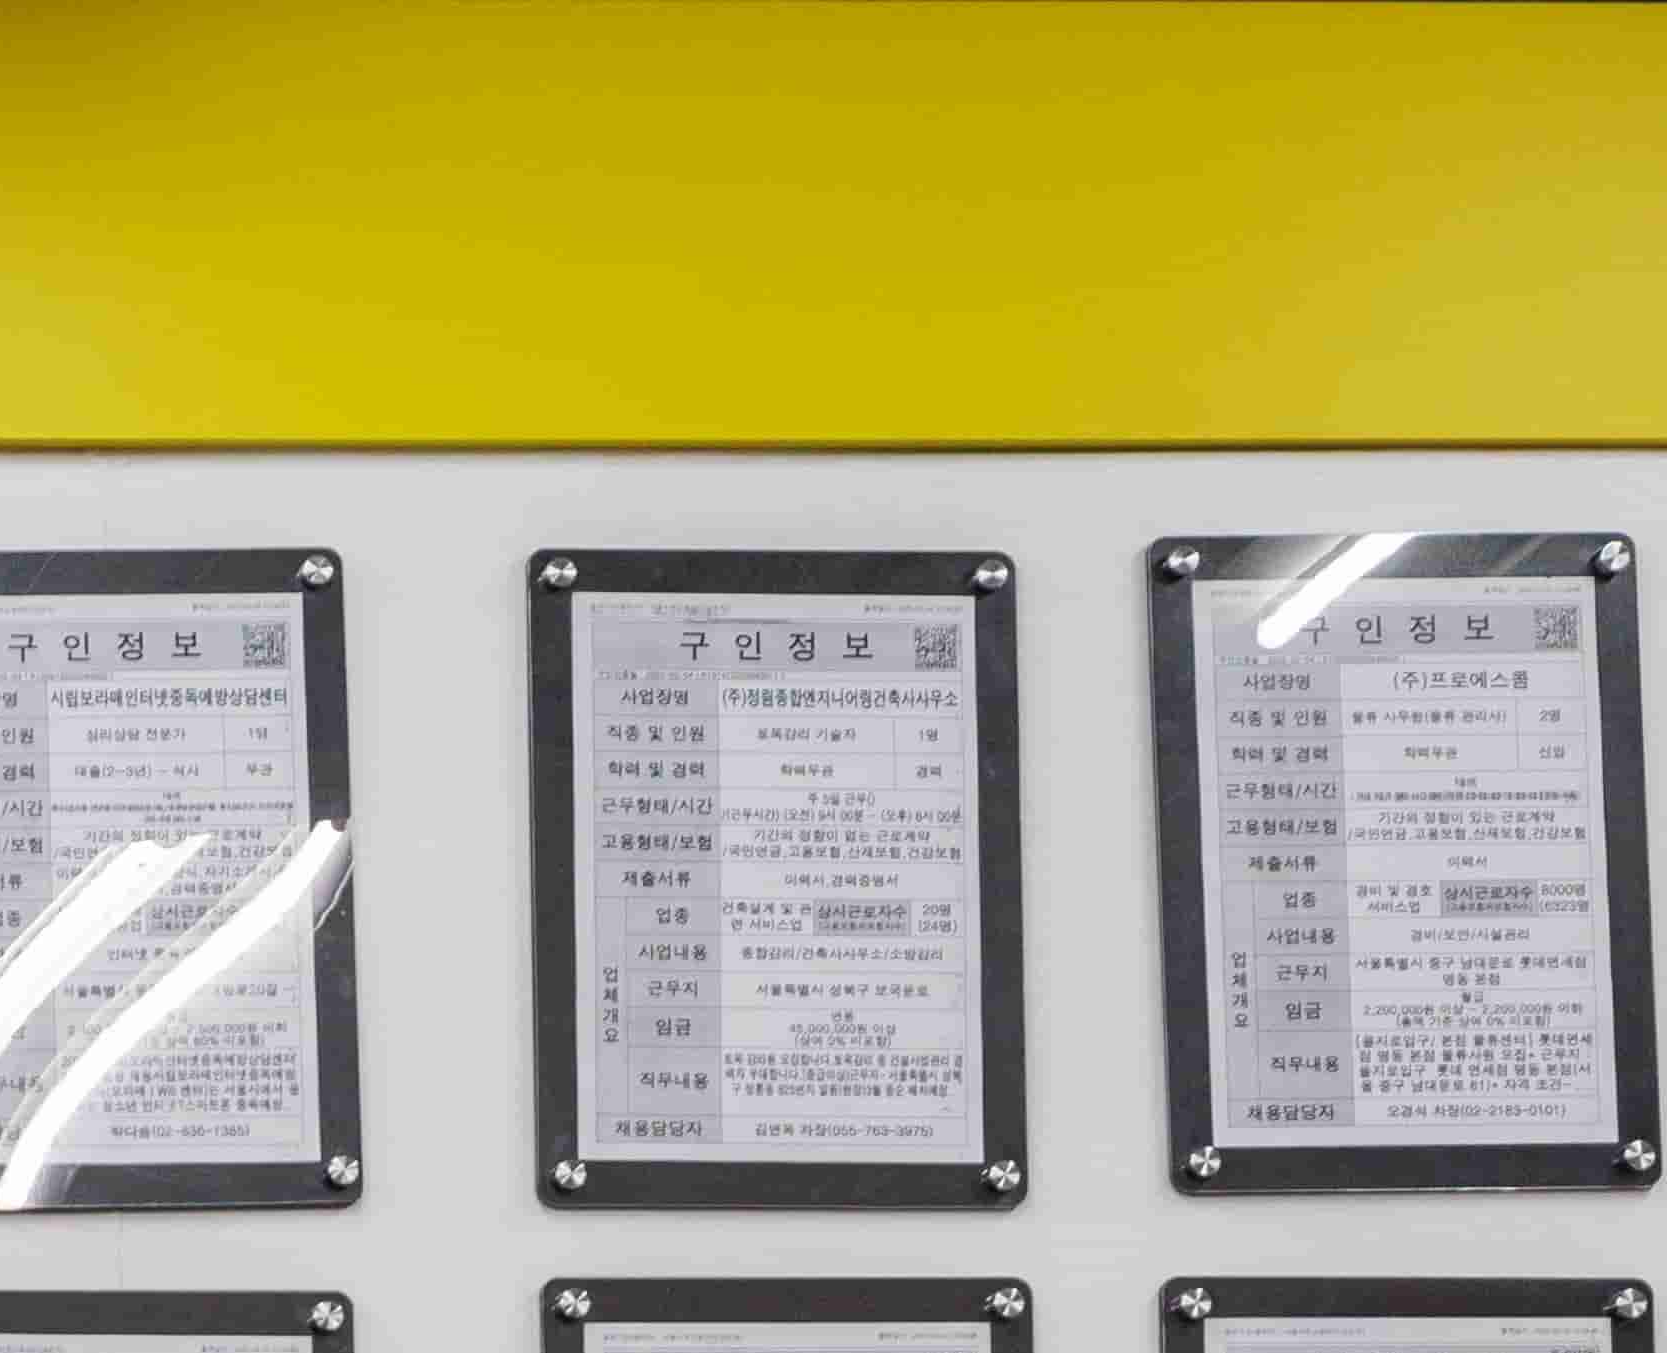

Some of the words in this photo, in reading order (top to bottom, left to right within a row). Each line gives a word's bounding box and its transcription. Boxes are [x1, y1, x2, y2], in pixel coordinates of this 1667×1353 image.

[1242, 671, 1311, 692] 사업장명
[1392, 669, 1529, 693] (주)프로에스콤
[621, 687, 689, 707] 사업장명
[1226, 780, 1338, 801] 근무형태/시간
[602, 795, 716, 817] 근무형태/시간
[1226, 818, 1338, 837] 고용형태/보험
[602, 832, 713, 852] 고용형태/보험
